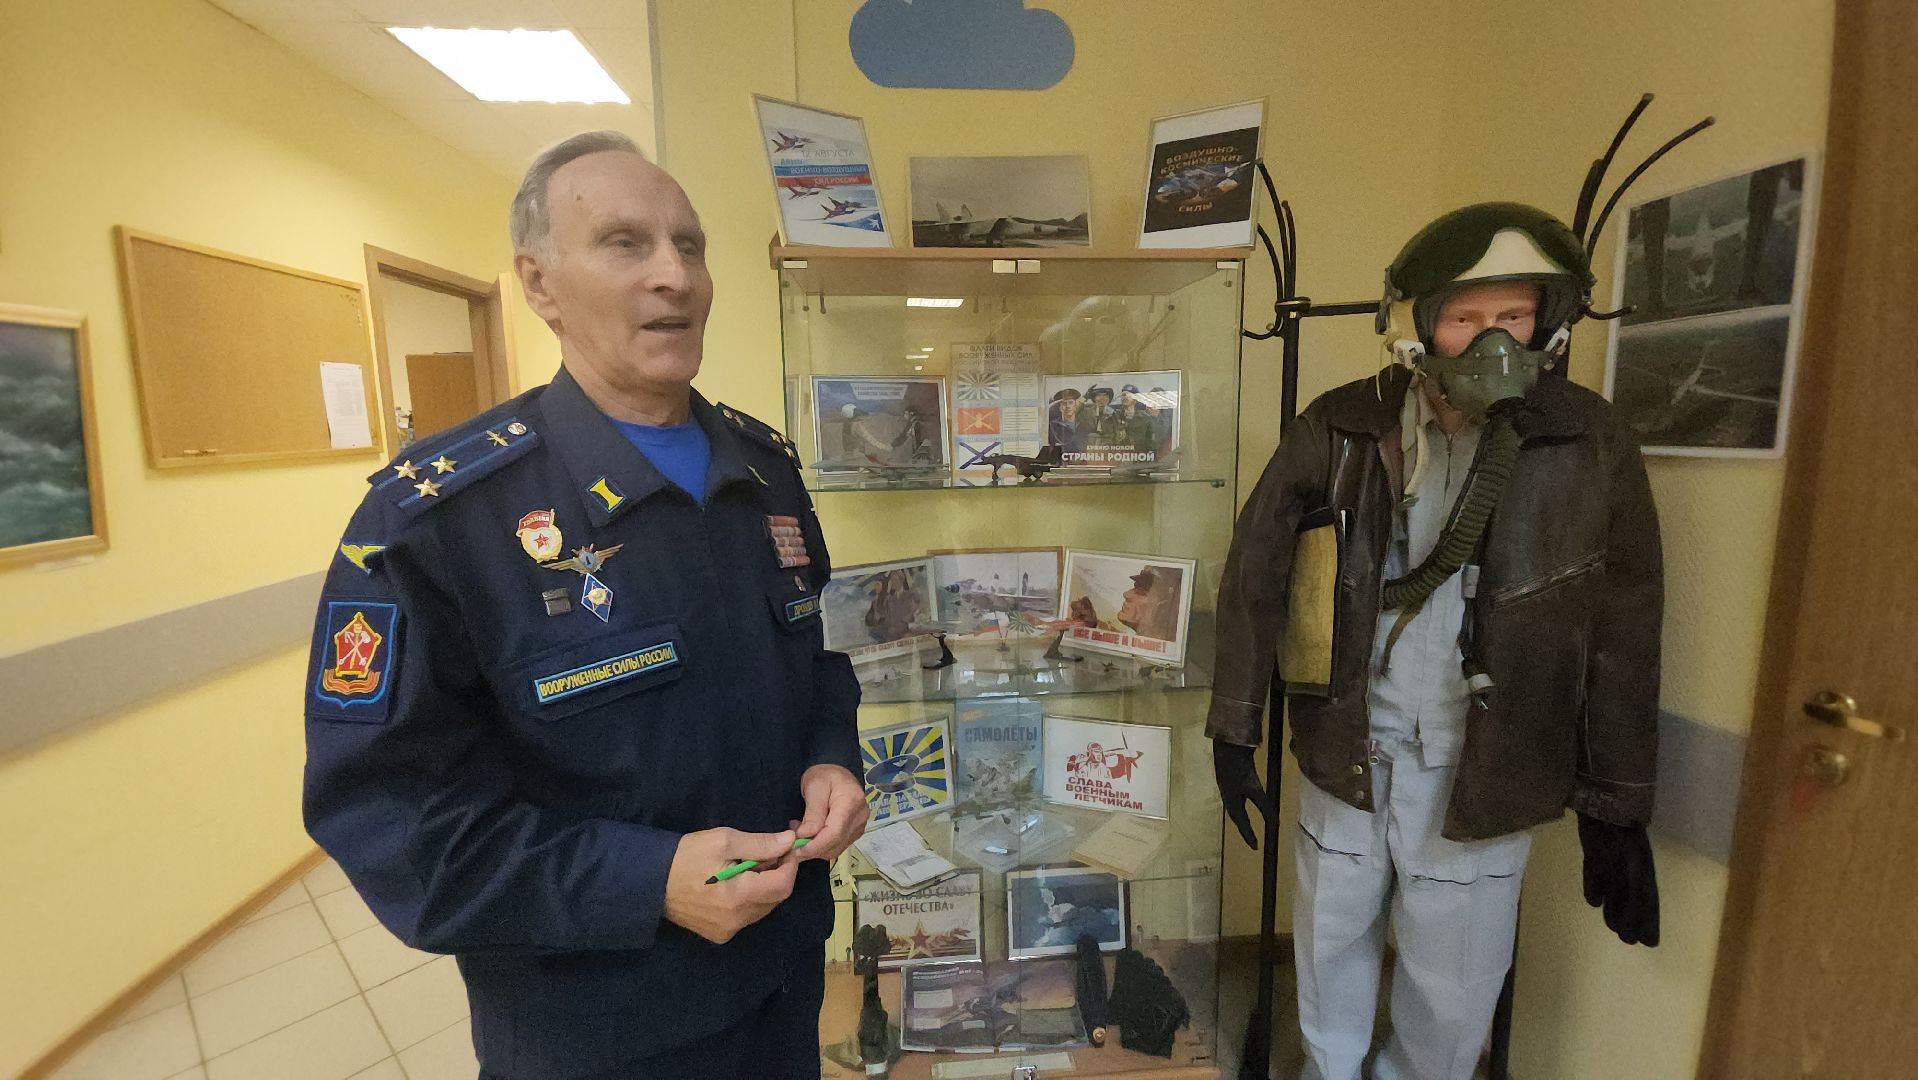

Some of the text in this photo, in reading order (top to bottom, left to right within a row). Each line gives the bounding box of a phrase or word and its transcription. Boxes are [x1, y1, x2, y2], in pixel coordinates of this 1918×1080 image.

[814, 148, 856, 158] АВГУСТА
[1166, 146, 1240, 164] ВОЗДУШНО-
[1161, 155, 1243, 174] КОСМИЧЕСКИЕ
[1179, 201, 1213, 213] СИЛЫ
[1061, 451, 1155, 462] СТРАНЫ РОДНОЙ
[1121, 635, 1129, 646] И
[539, 646, 673, 697] ВООРУЖЕННЫЕ СИЛЫ РОССИИ
[965, 724, 1038, 742] САМОЛЁТЫ
[1068, 776, 1112, 789] СЛАВА
[1065, 784, 1130, 799] ВОЕННЫМ
[1074, 793, 1143, 810] ЛЕТЧИКАМ
[883, 900, 954, 916] ОТЕЧЕСТВА»
